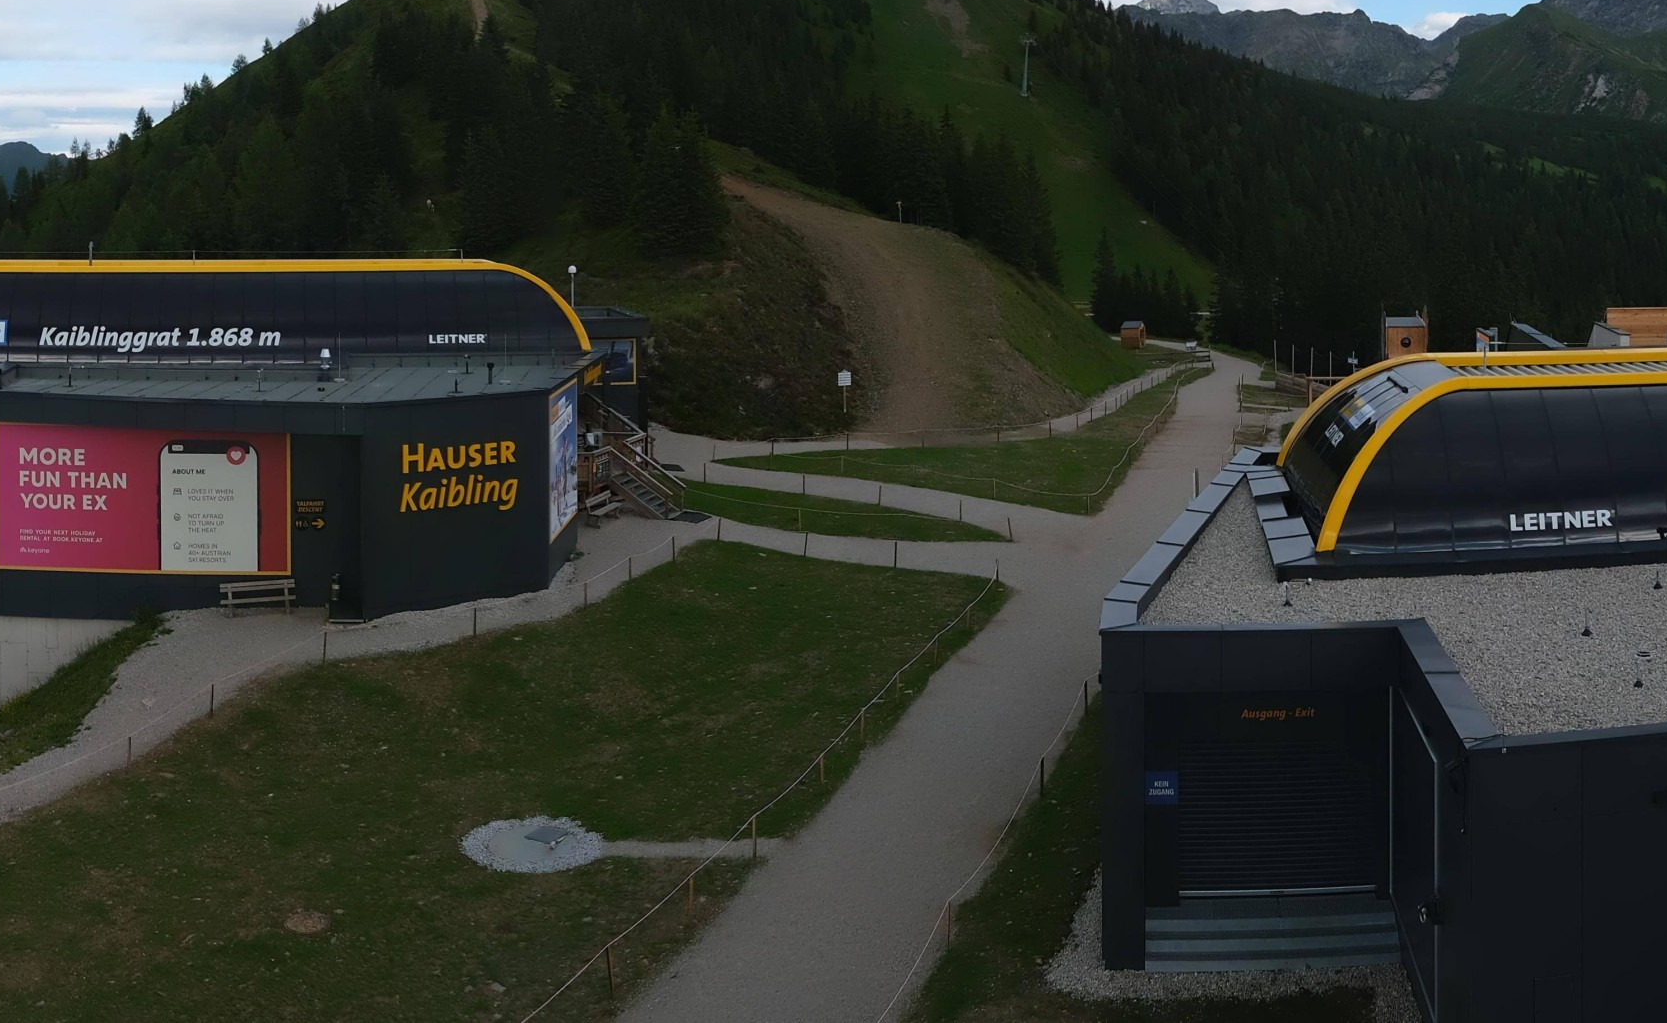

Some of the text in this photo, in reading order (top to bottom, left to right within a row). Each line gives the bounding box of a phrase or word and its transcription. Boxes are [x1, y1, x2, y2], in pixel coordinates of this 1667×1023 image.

[39, 326, 281, 353] Kaiblinggrat 1.868 m
[428, 333, 487, 344] LEITNER
[19, 447, 85, 466] MORE
[402, 440, 517, 474] HAUSER
[19, 470, 127, 489] FUN THAN
[20, 493, 108, 511] YOUR EX
[400, 475, 519, 513] Kaibling
[1509, 509, 1614, 531] LEITNER
[27, 546, 50, 554] keyone
[1241, 709, 1286, 720] Ausgang
[1295, 707, 1315, 717] Exit
[1148, 788, 1175, 796] ZUGANG
[1154, 780, 1169, 788] KEIN
